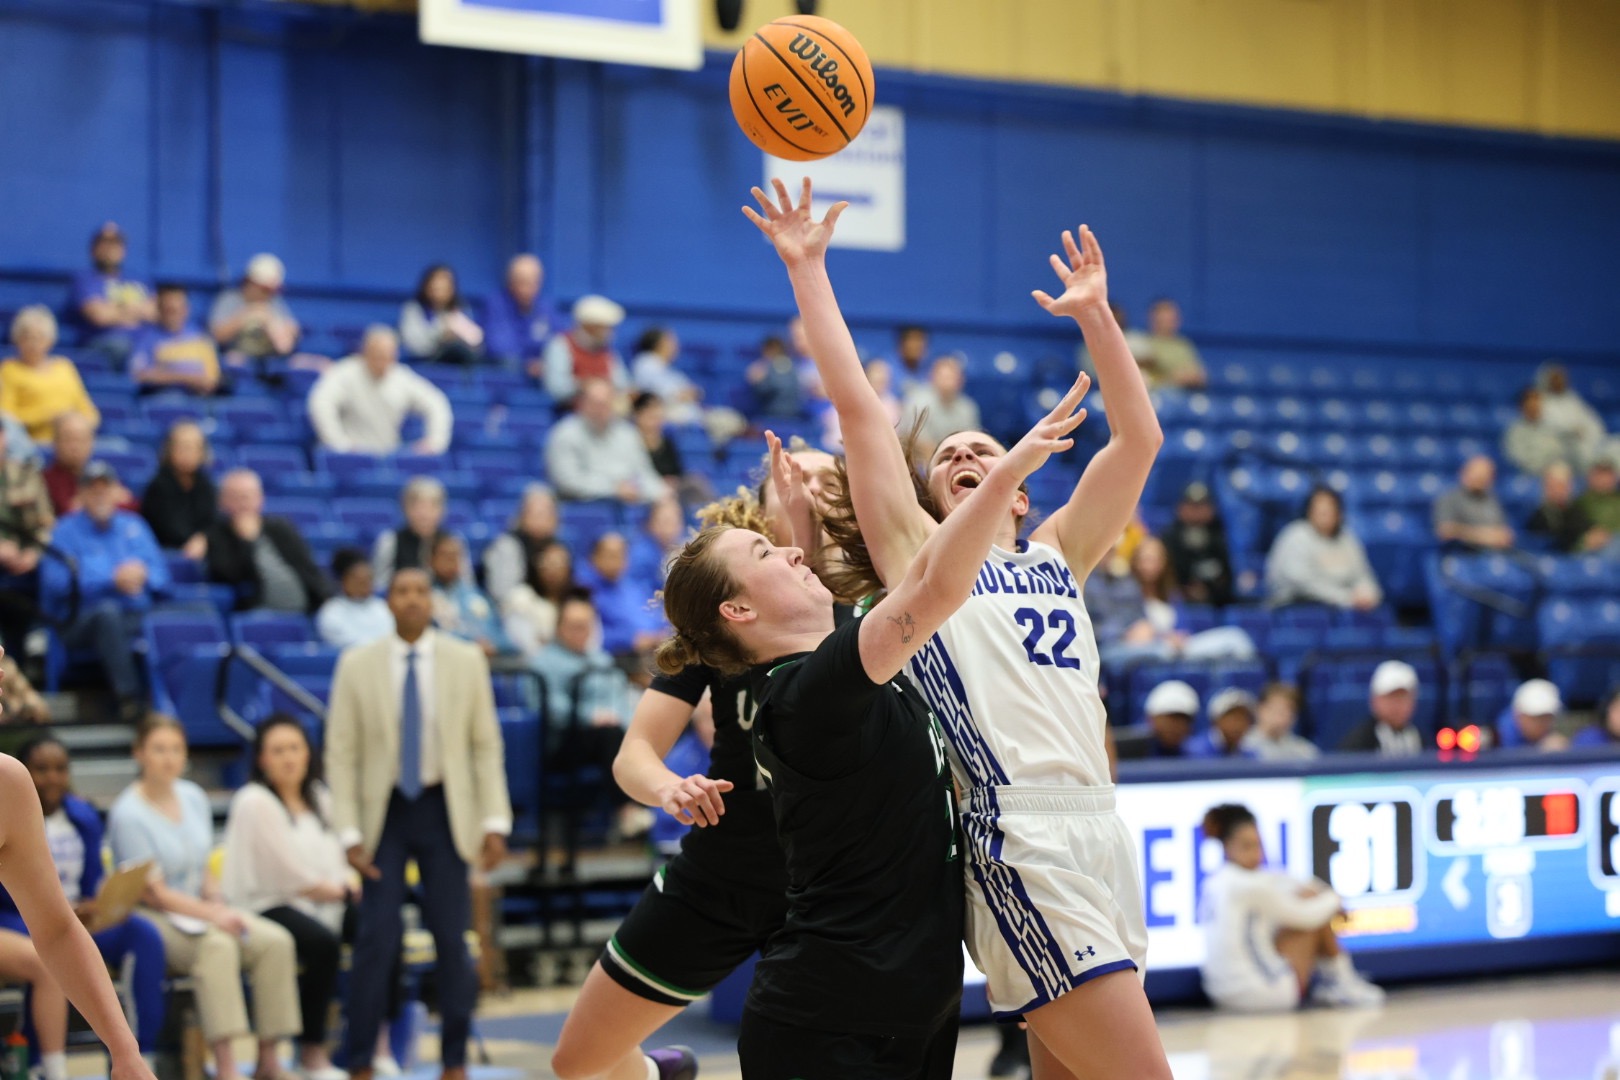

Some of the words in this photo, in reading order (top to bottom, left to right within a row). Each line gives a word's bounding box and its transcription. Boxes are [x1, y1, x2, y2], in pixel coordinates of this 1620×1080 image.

[763, 83, 814, 131] EVO
[788, 32, 856, 119] Wilson
[1014, 607, 1081, 671] 22
